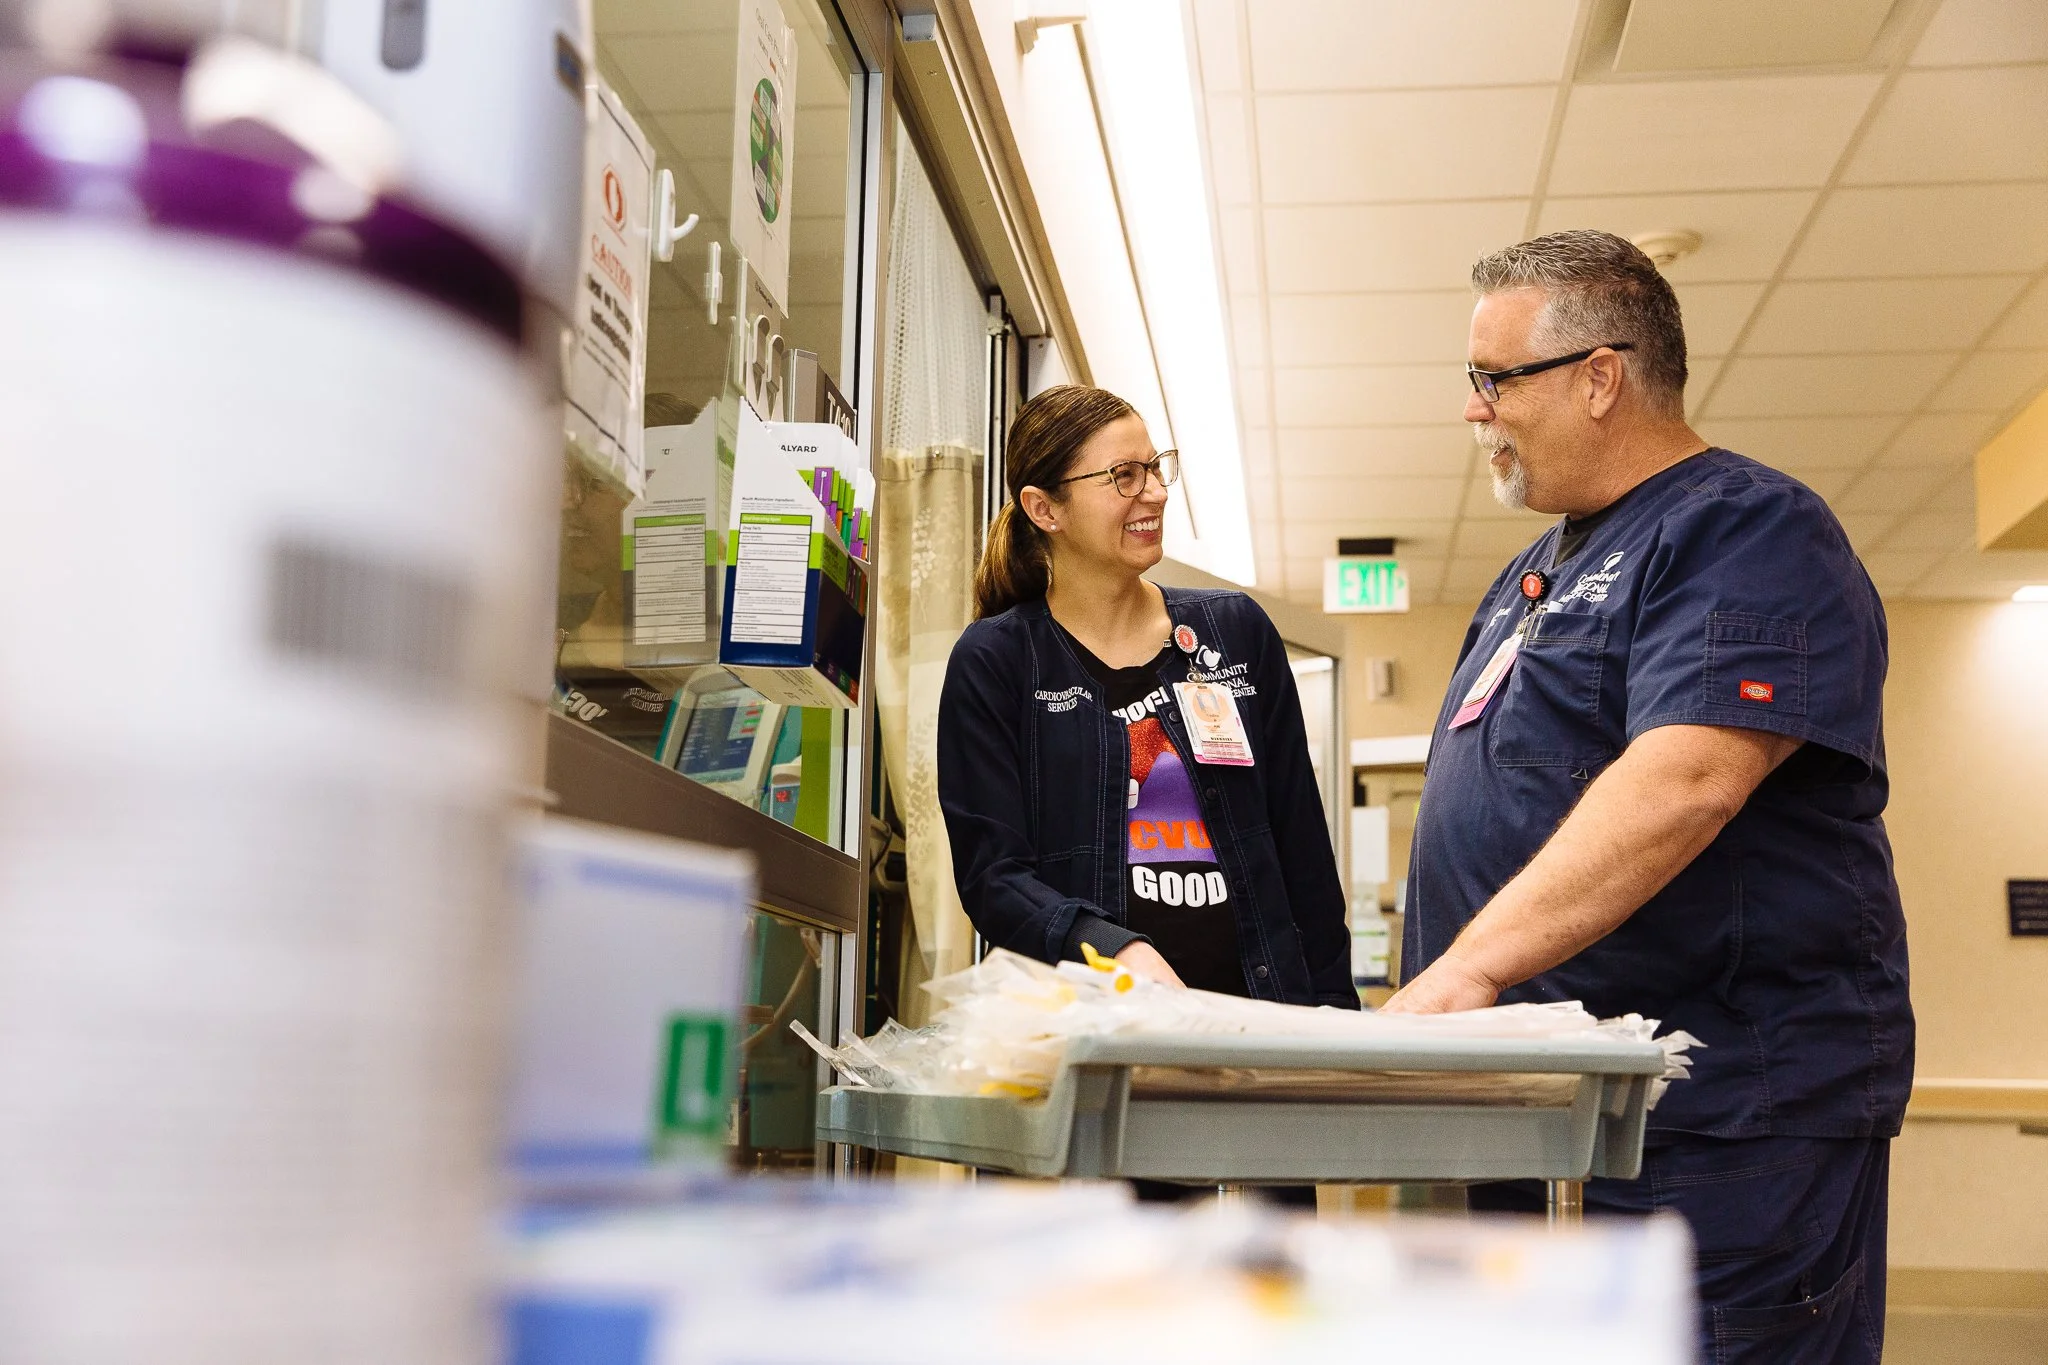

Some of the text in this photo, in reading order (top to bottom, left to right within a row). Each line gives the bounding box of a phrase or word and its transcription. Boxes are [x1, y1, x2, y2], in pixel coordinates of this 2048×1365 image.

[779, 444, 818, 453] ALYARD
[1338, 561, 1399, 606] EXIT
[1034, 686, 1093, 702] CARDIOVASCULAR
[1047, 696, 1078, 712] SERVICES
[1132, 865, 1228, 908] GOOD
